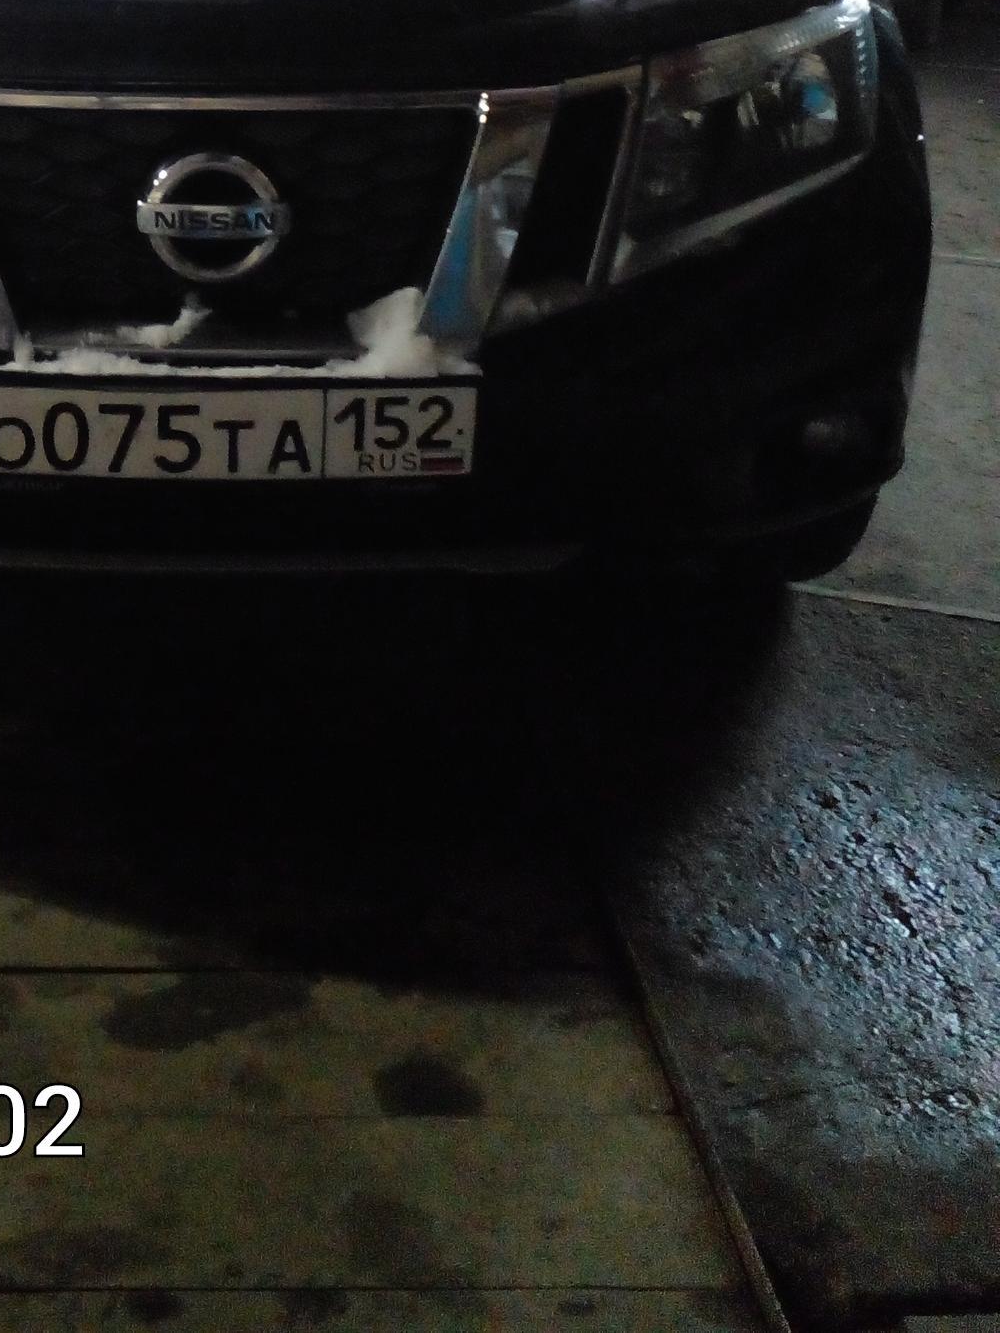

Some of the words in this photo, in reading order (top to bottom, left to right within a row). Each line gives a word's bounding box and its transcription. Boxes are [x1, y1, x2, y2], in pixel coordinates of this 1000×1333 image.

[154, 211, 275, 231] NISSAN
[334, 395, 454, 452] 152
[357, 453, 418, 473] RUS
